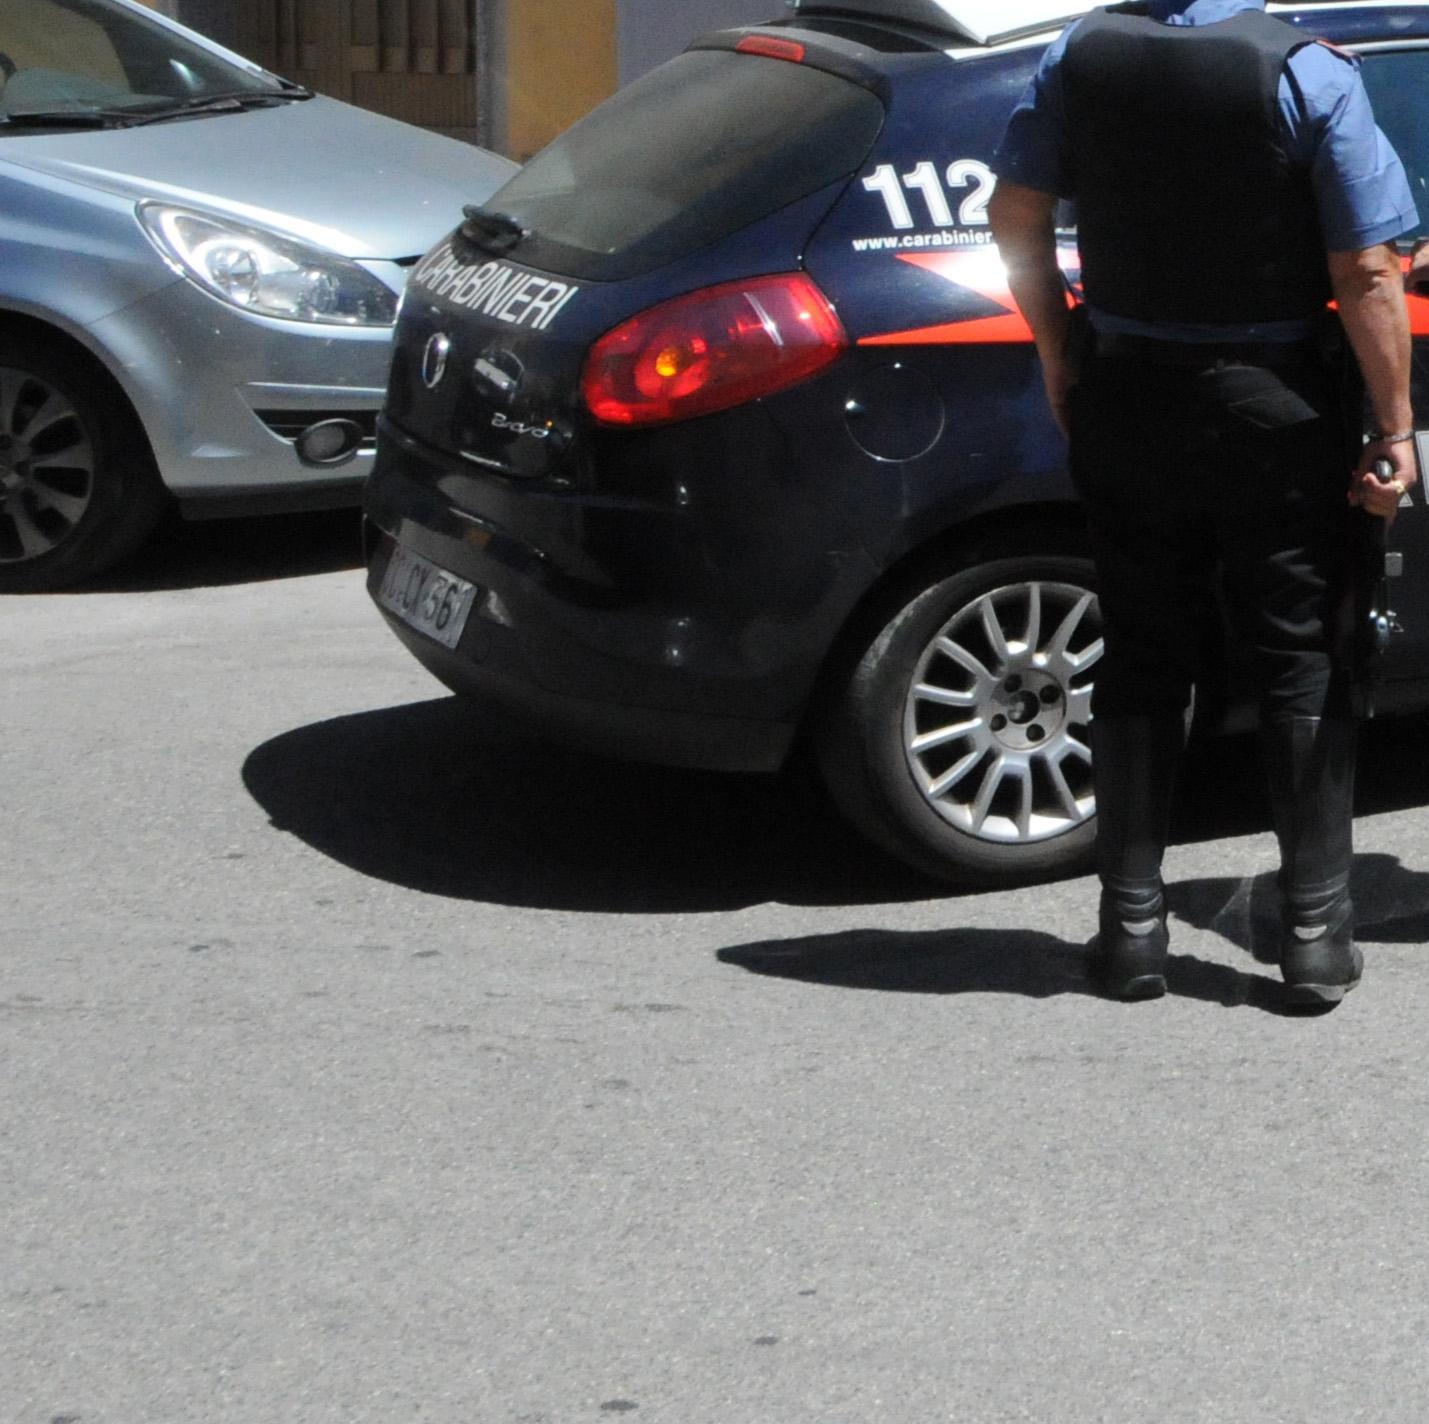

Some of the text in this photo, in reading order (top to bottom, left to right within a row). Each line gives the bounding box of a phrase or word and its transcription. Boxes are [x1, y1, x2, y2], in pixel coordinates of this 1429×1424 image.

[861, 158, 998, 229] 112
[851, 230, 993, 252] www.carabinier
[415, 243, 580, 331] CARABINIERI
